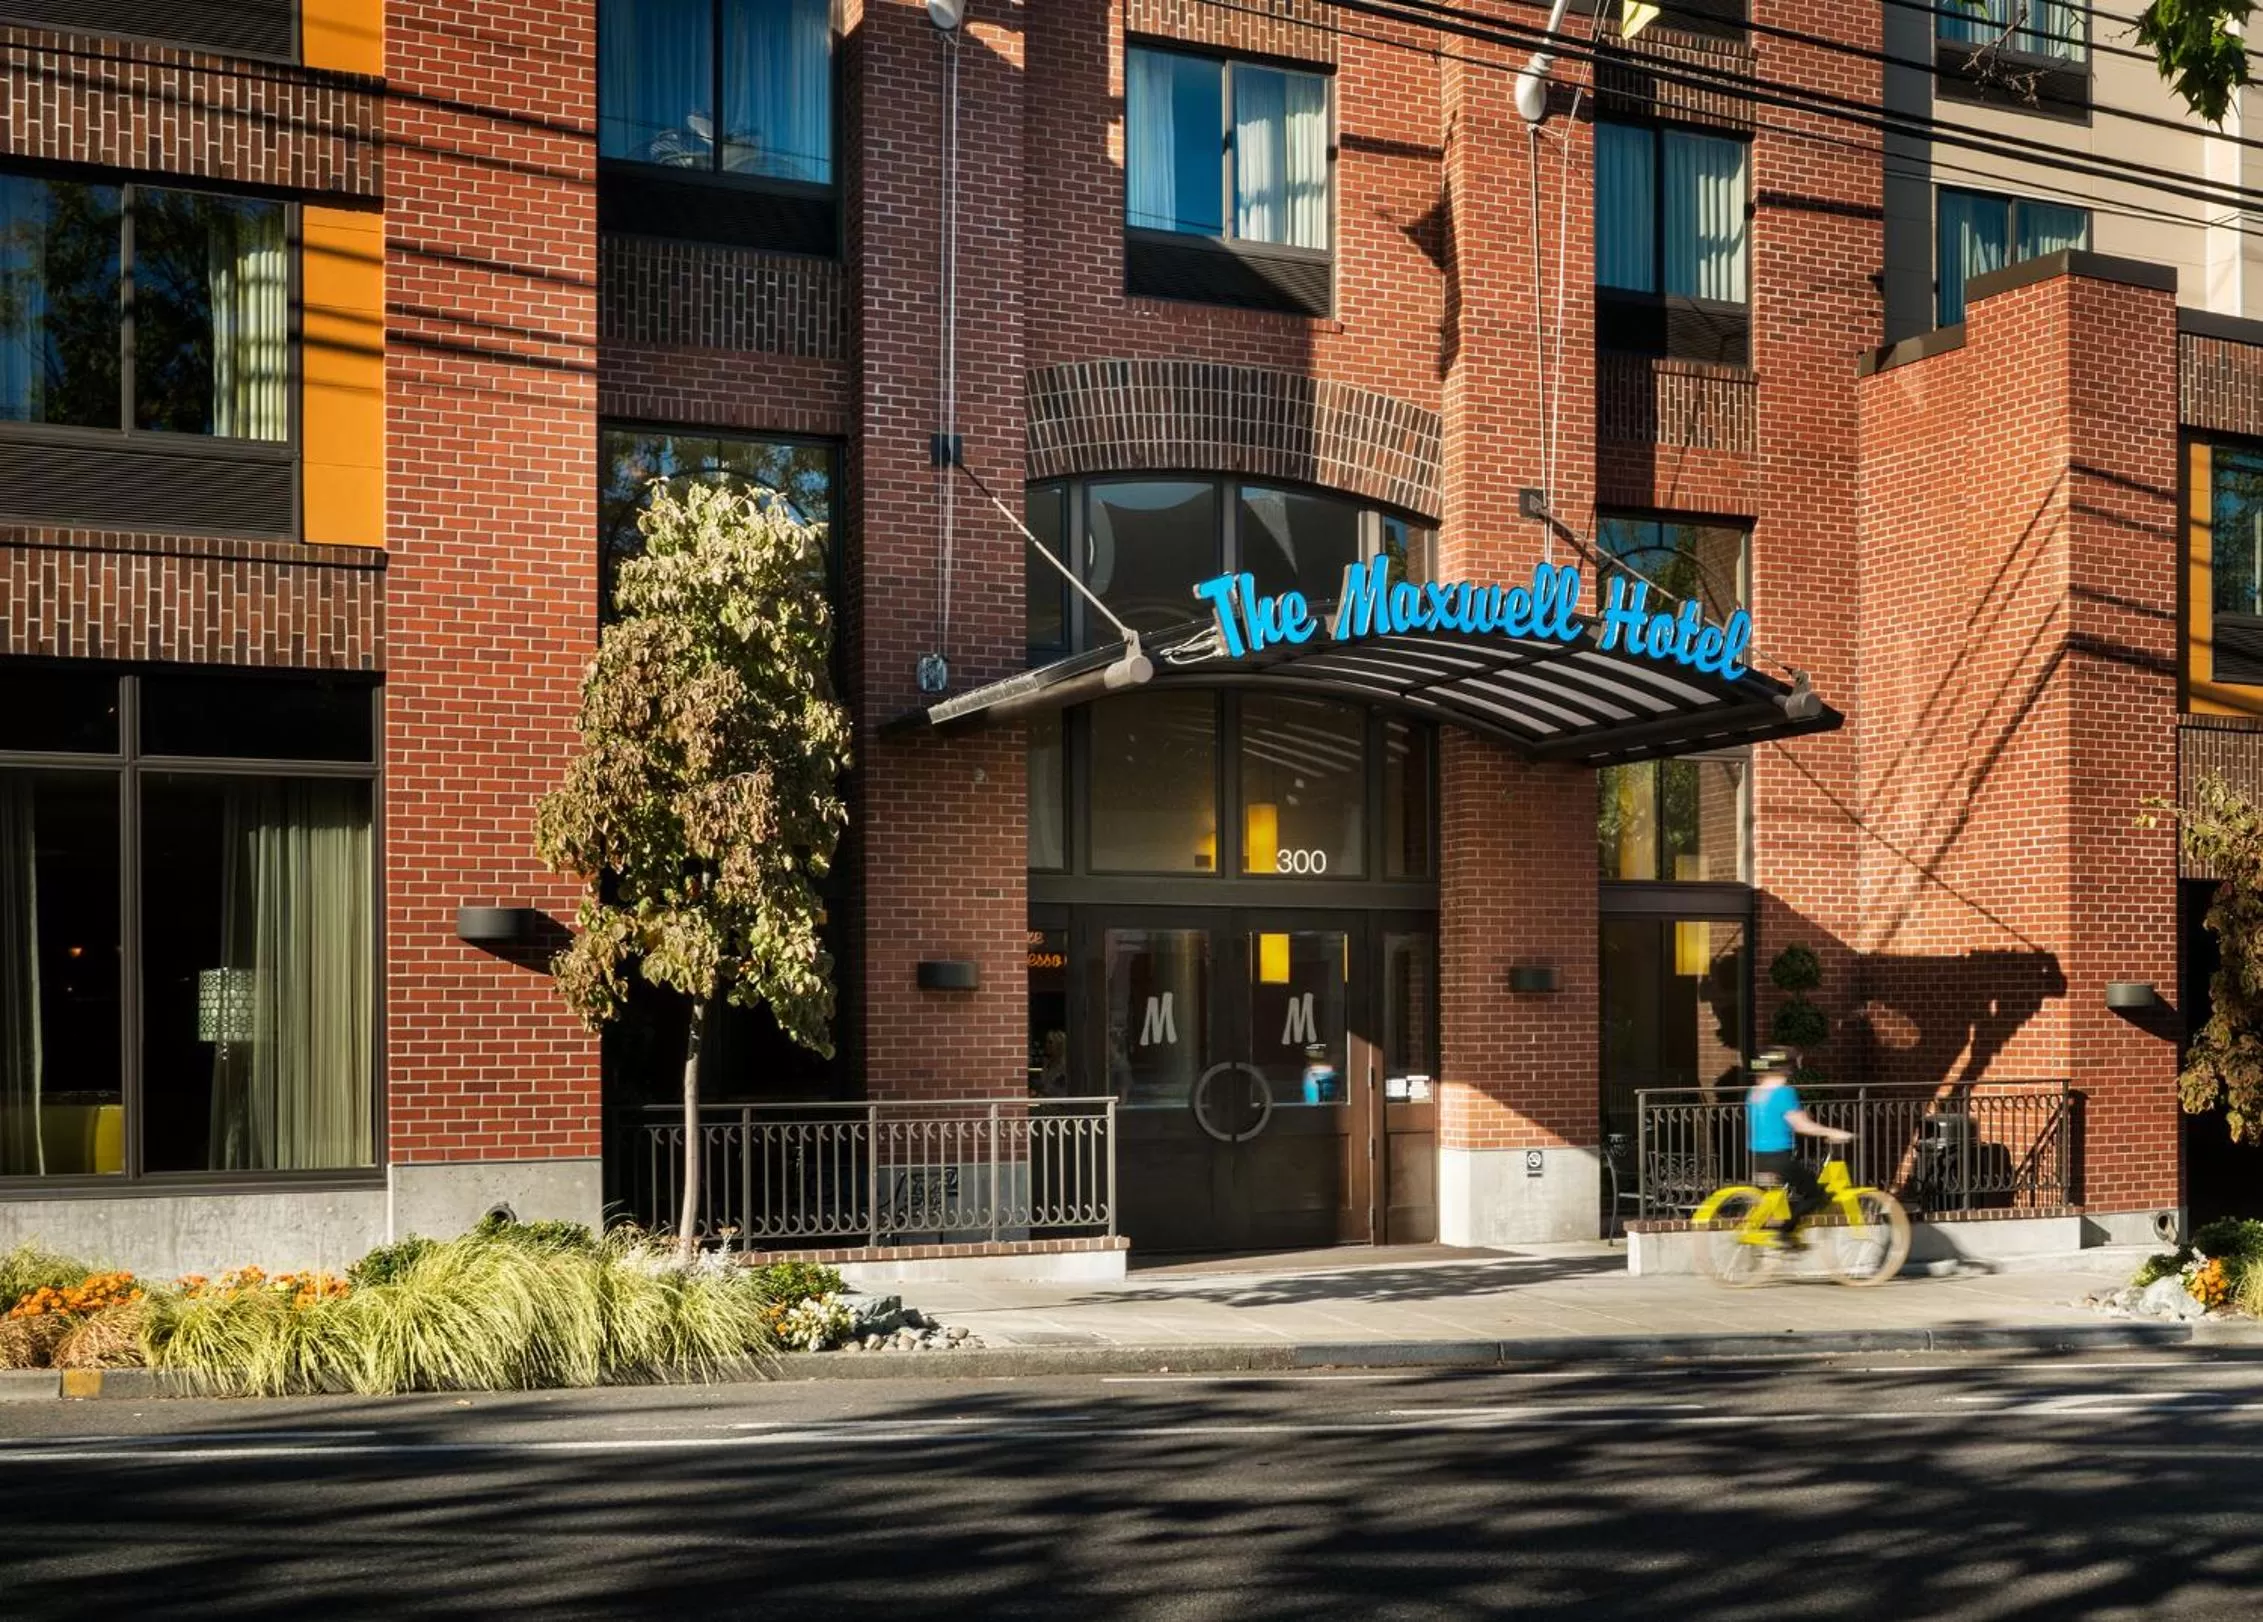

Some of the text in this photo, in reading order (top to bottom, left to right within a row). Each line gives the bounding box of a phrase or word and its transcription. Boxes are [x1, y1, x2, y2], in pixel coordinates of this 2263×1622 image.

[1195, 553, 1752, 681] The Maxwell Hotel
[1276, 849, 1327, 873] 300
[1140, 991, 1177, 1046] M
[1281, 992, 1317, 1045] M
